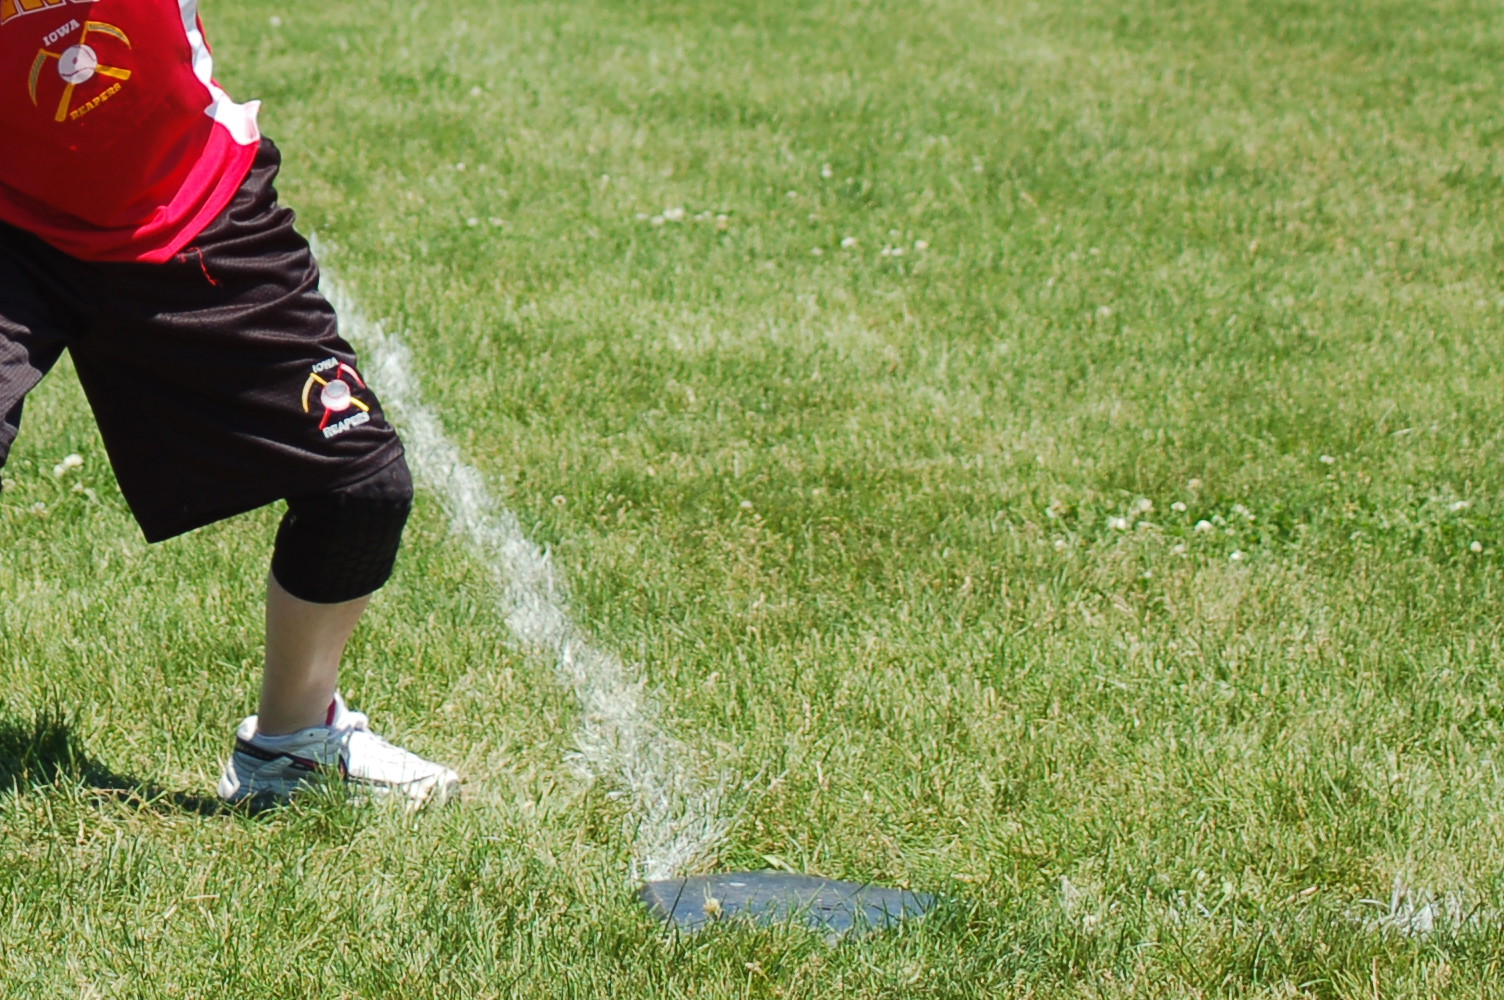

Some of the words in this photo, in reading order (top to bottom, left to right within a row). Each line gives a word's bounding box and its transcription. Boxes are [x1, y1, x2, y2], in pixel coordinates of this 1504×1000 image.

[42, 18, 81, 47] IOWA
[69, 82, 122, 121] REAPERS
[312, 356, 339, 373] IOWA
